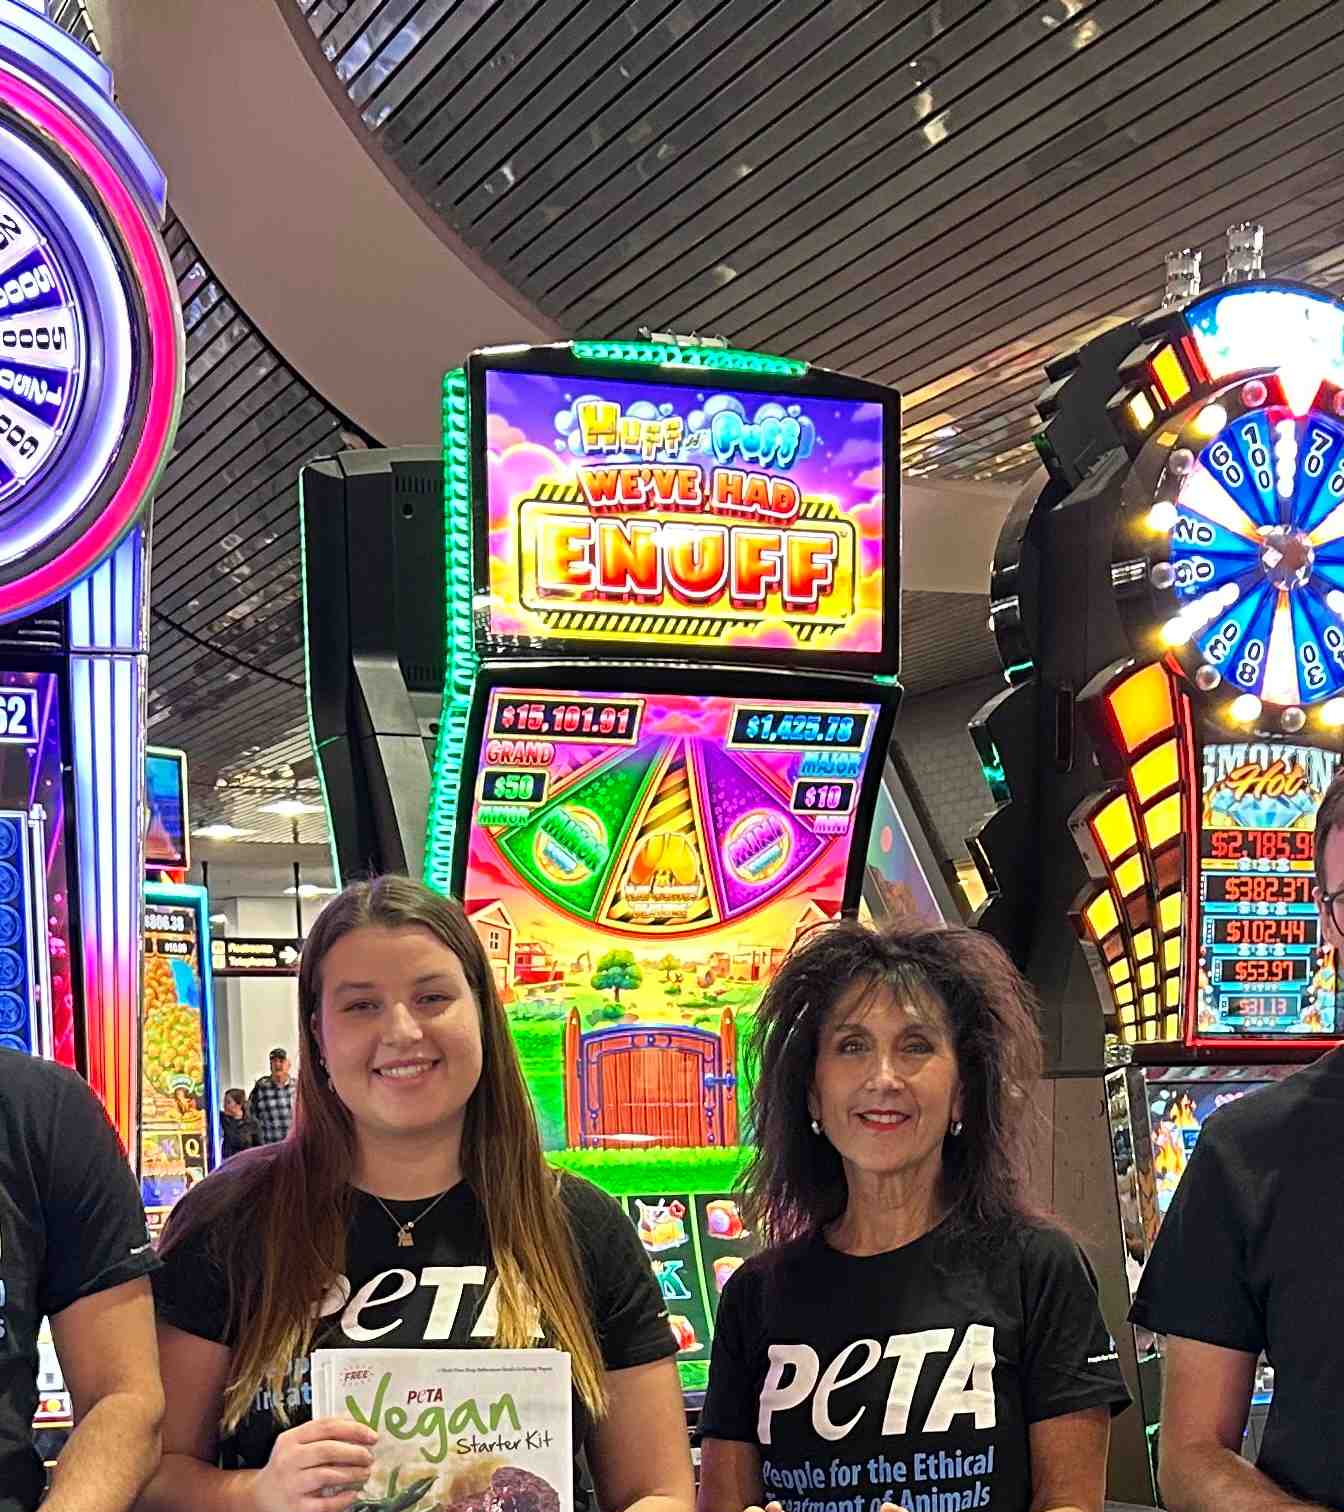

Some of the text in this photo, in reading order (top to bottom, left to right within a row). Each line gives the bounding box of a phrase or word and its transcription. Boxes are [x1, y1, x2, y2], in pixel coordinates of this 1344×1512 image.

[1208, 444, 1244, 487] 60
[1241, 424, 1272, 492] 100
[1306, 429, 1341, 476] 70
[580, 464, 801, 522] WE'VE HAD
[1175, 517, 1214, 544] 20
[537, 517, 839, 610] ENUFF
[1206, 621, 1239, 661] 30
[1237, 639, 1264, 685] 80
[1299, 643, 1325, 689] 30
[502, 704, 630, 735] $15,101.91
[746, 714, 854, 742] $1,425.78
[486, 740, 555, 766] GRAND
[494, 774, 534, 800] $50
[805, 785, 841, 809] $10
[1226, 760, 1307, 801] Hot
[1225, 877, 1310, 902] $382.37
[1227, 920, 1305, 944] $102.44
[1235, 961, 1294, 981] $53.97
[184, 1137, 200, 1158] Q
[344, 1369, 369, 1382] FREE
[757, 1324, 997, 1445] PeTA
[345, 1372, 522, 1463] Vegan
[456, 1430, 554, 1456] Starter Kit
[763, 1446, 994, 1491] People for the Ethical
